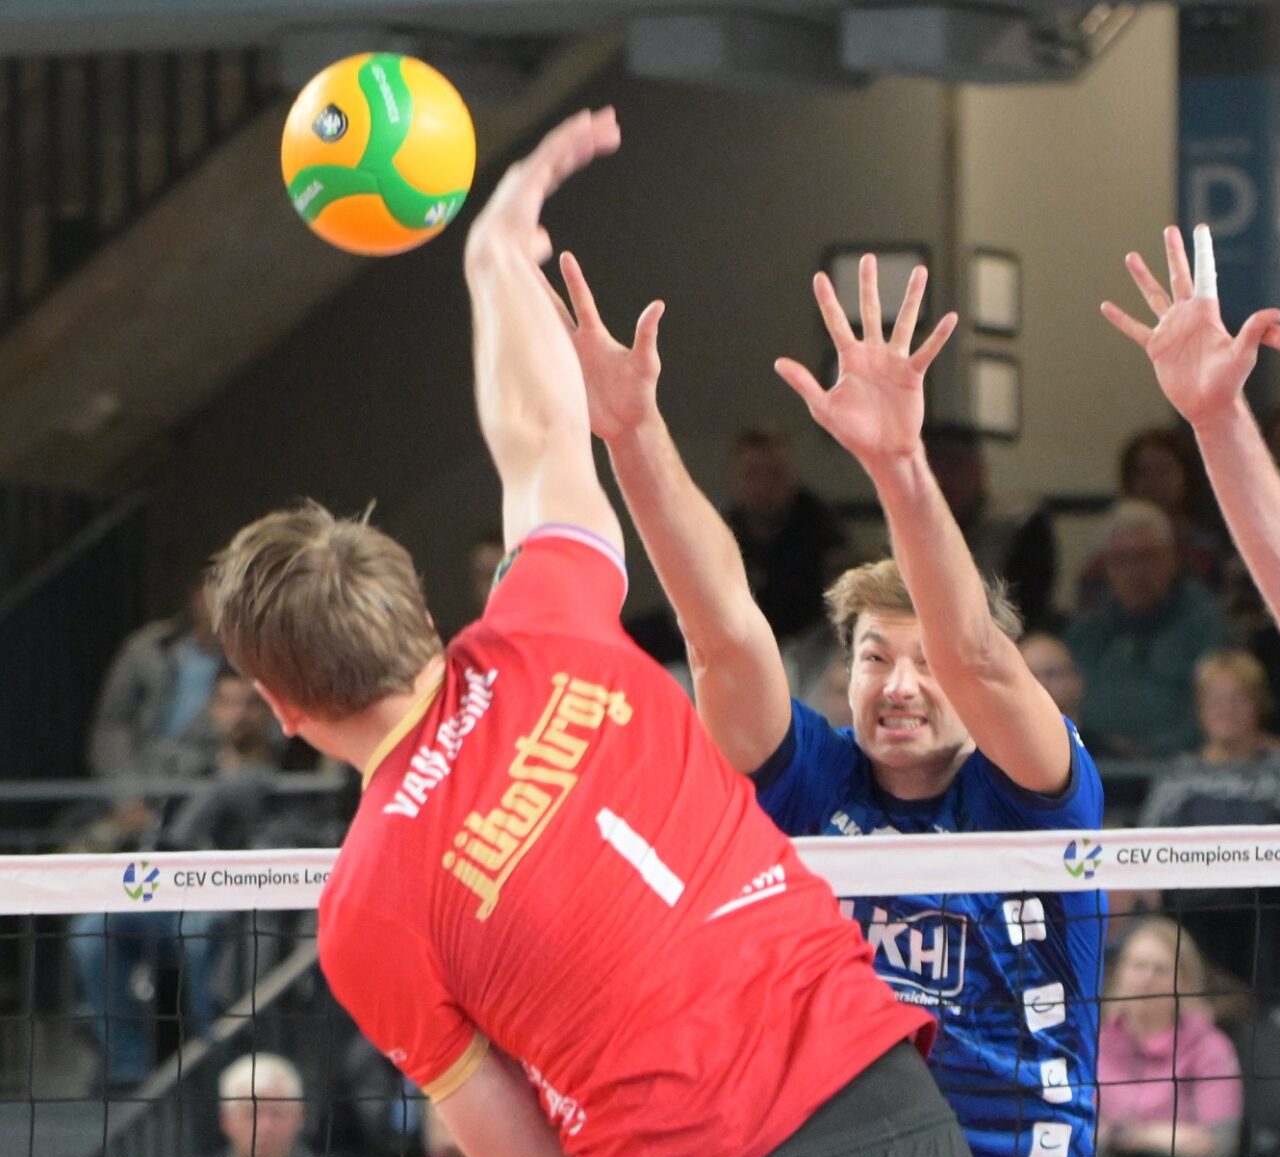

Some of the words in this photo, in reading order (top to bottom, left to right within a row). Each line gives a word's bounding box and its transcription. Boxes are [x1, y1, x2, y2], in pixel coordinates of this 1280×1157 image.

[595, 806, 686, 908] 1
[1116, 848, 1152, 865] CEV
[1156, 846, 1250, 867] Champions
[173, 871, 207, 887] CEV
[211, 868, 300, 889] Champions
